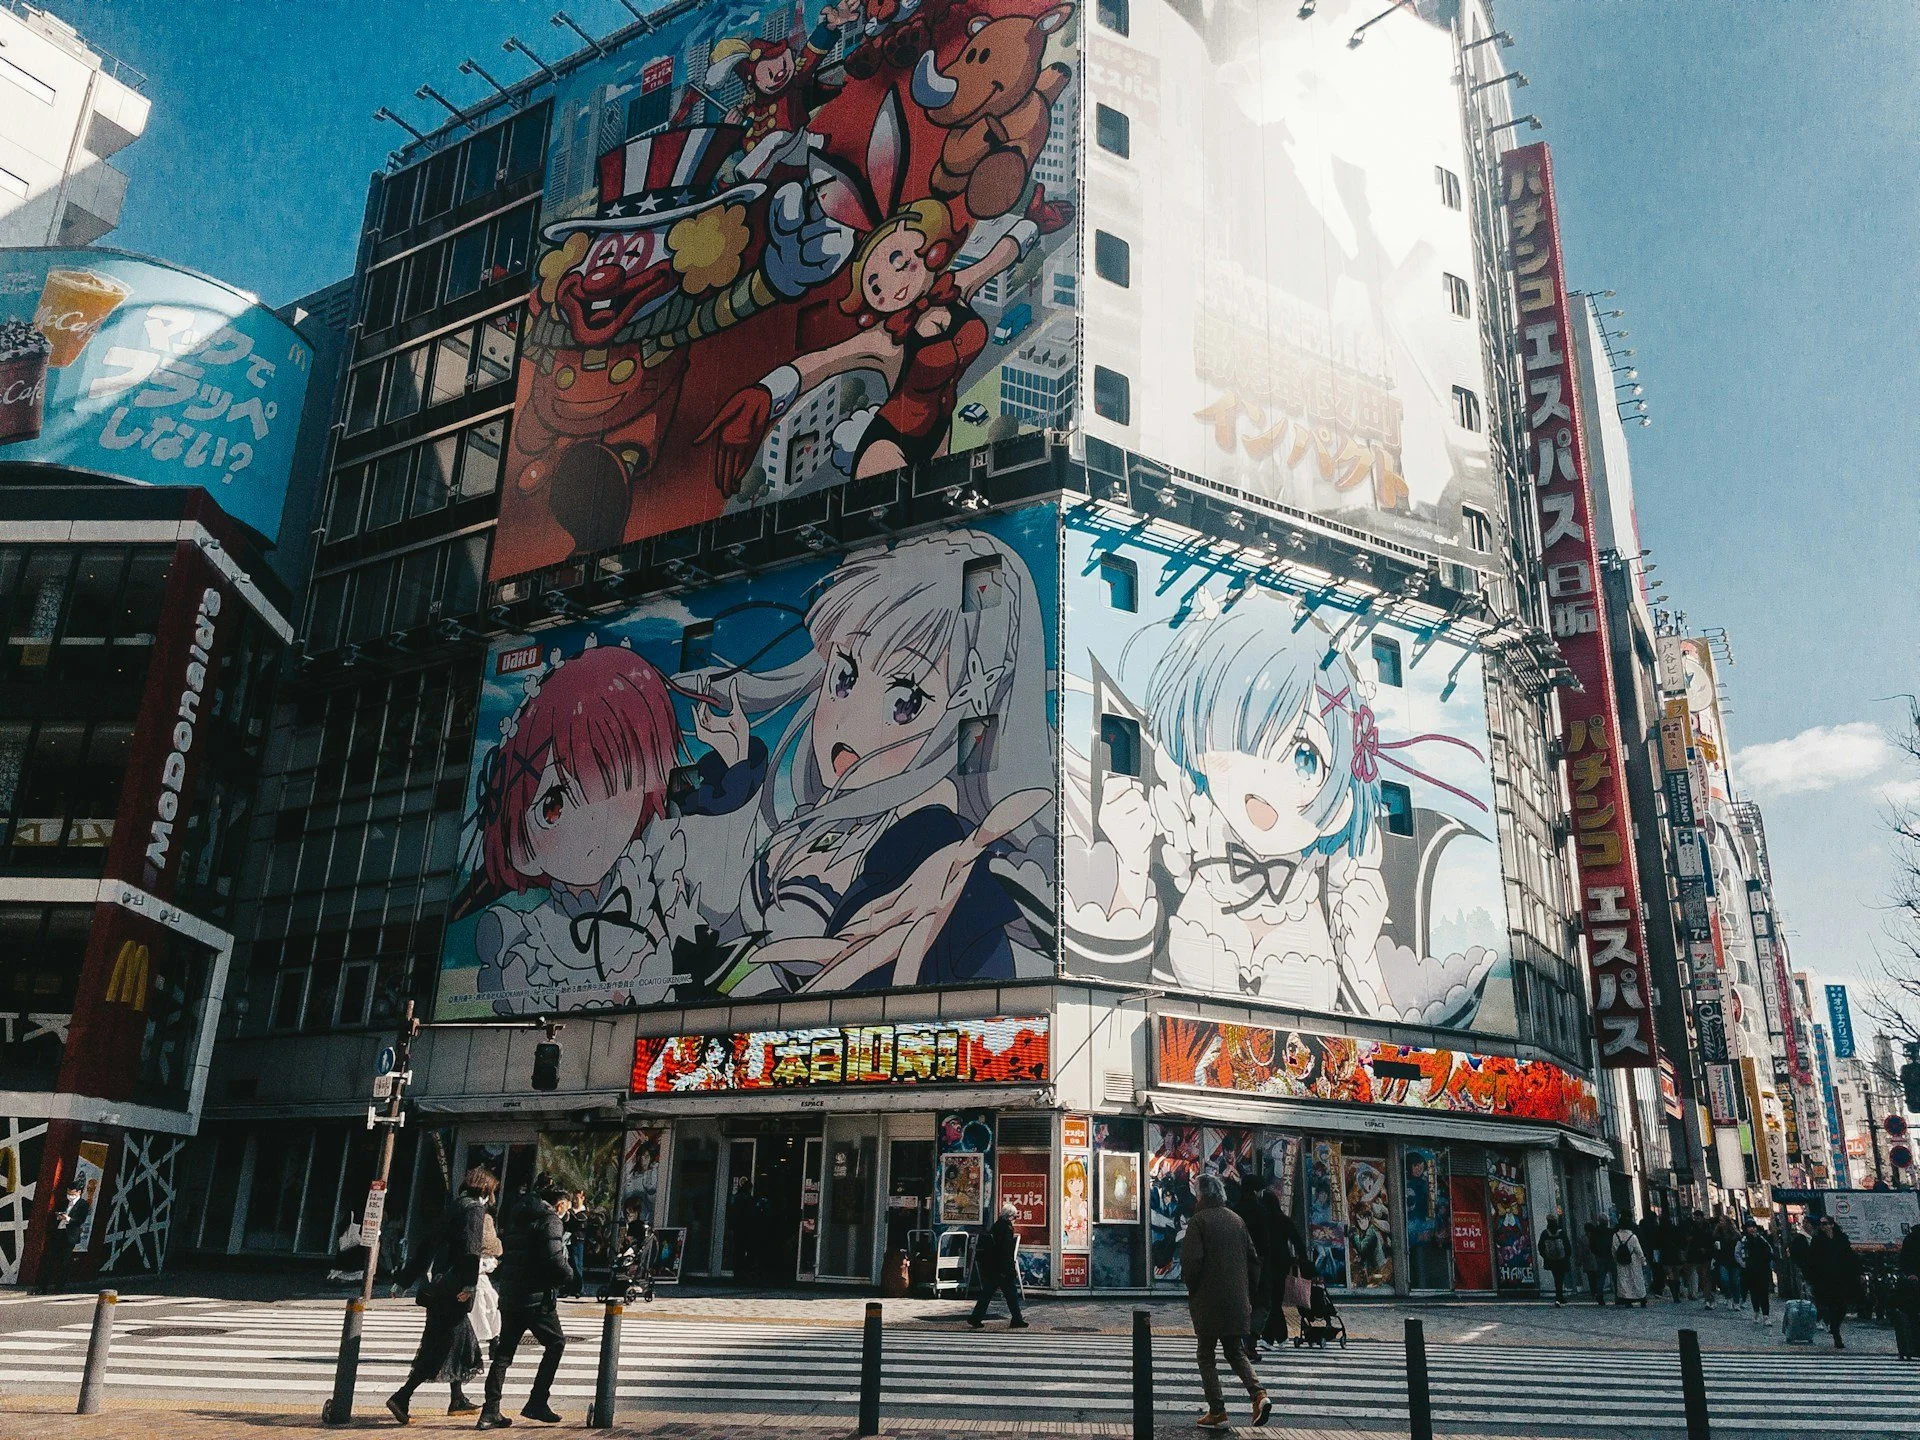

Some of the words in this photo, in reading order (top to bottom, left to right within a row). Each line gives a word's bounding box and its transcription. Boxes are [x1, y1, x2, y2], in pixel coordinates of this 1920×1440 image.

[1508, 161, 1556, 313] パチンコ
[88, 346, 278, 441] フラッペ
[1193, 390, 1410, 509] インパクト
[1525, 320, 1584, 548] エスパス
[1547, 560, 1598, 637] 日拓
[1663, 642, 1679, 685] 戸谷ビル
[145, 587, 221, 870] McDonald's
[1569, 714, 1623, 867] パチンコ
[1676, 774, 1687, 795] BUZZ
[1680, 794, 1690, 823] STAND
[1691, 928, 1708, 940] 7F
[1587, 886, 1650, 1056] エスパス
[1762, 961, 1776, 1030] KIBORI
[800, 1100, 824, 1108] ESPACE
[1364, 1121, 1386, 1129] ESPACE
[1065, 1129, 1085, 1138] エスパス
[1002, 1191, 1044, 1206] エスパス
[1455, 1225, 1482, 1237] エスパス
[1065, 1267, 1085, 1276] エスパス
